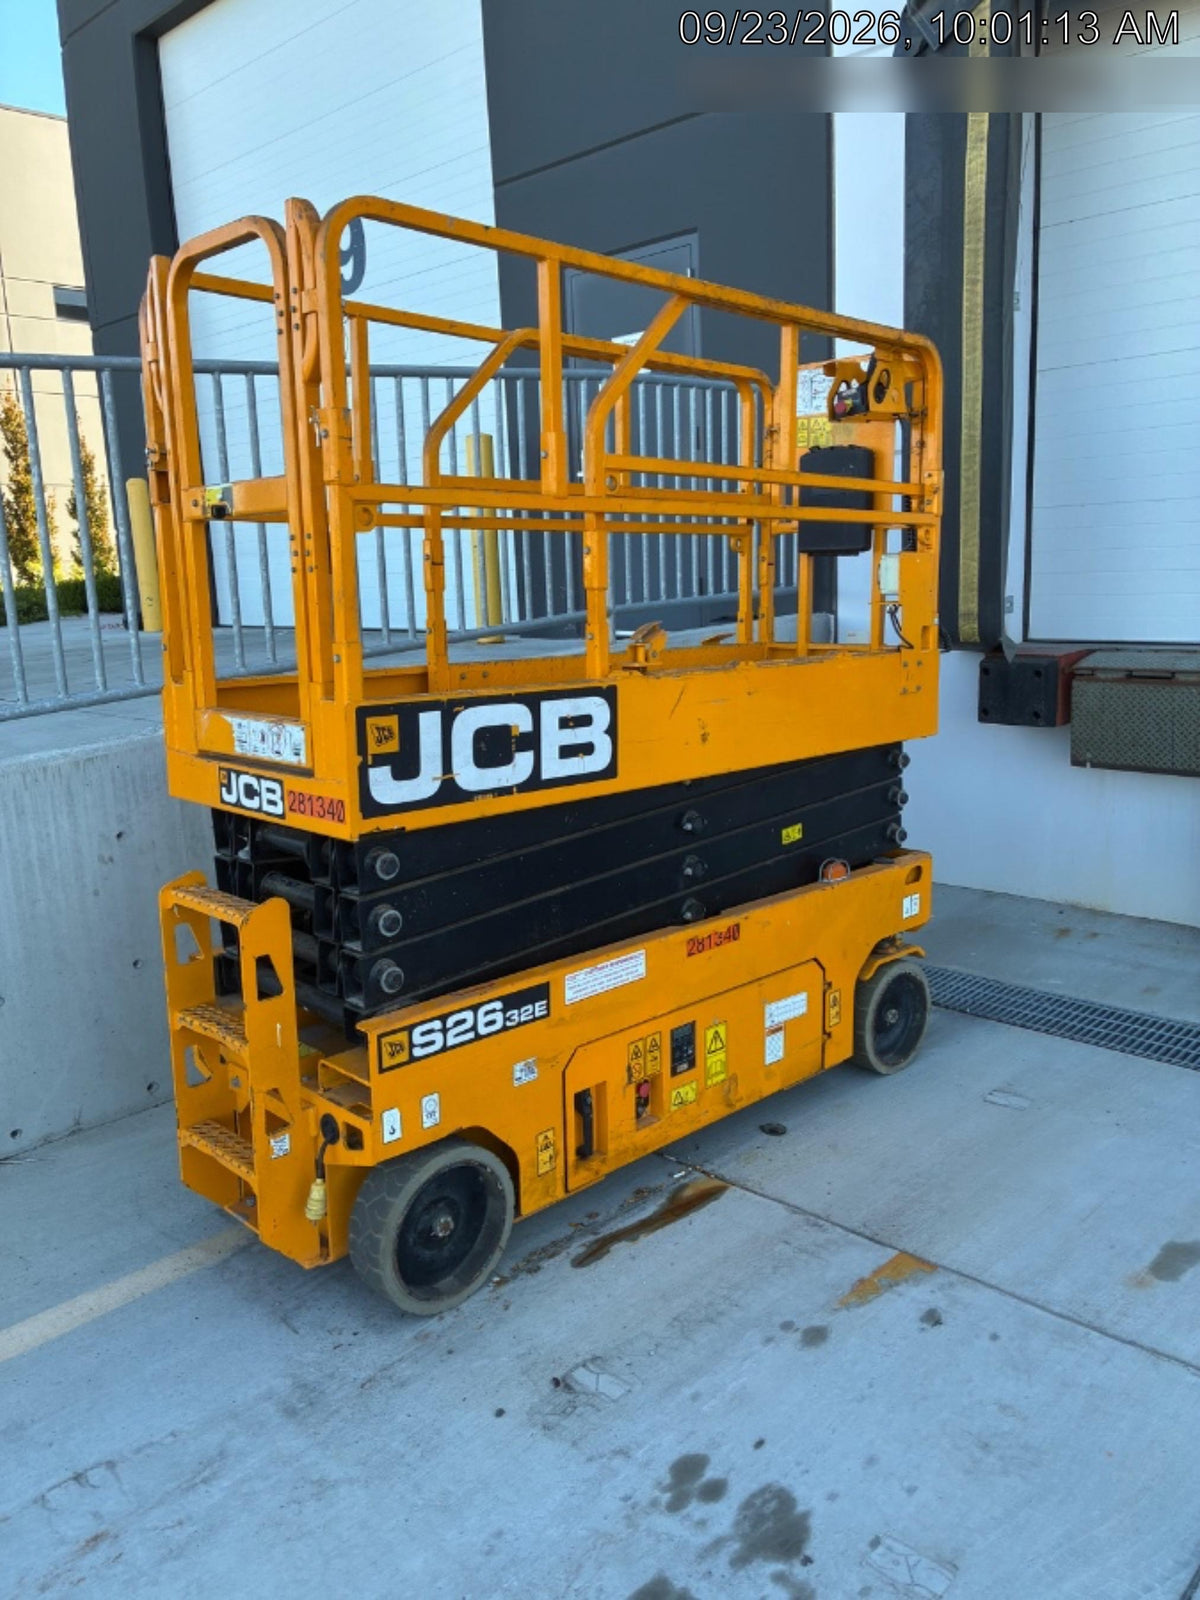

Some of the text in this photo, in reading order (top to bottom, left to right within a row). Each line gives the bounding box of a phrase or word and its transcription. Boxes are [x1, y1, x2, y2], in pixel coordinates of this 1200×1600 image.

[368, 696, 612, 805] JCB
[221, 770, 284, 816] JCB
[288, 790, 346, 823] 281340
[687, 922, 741, 957] 281340
